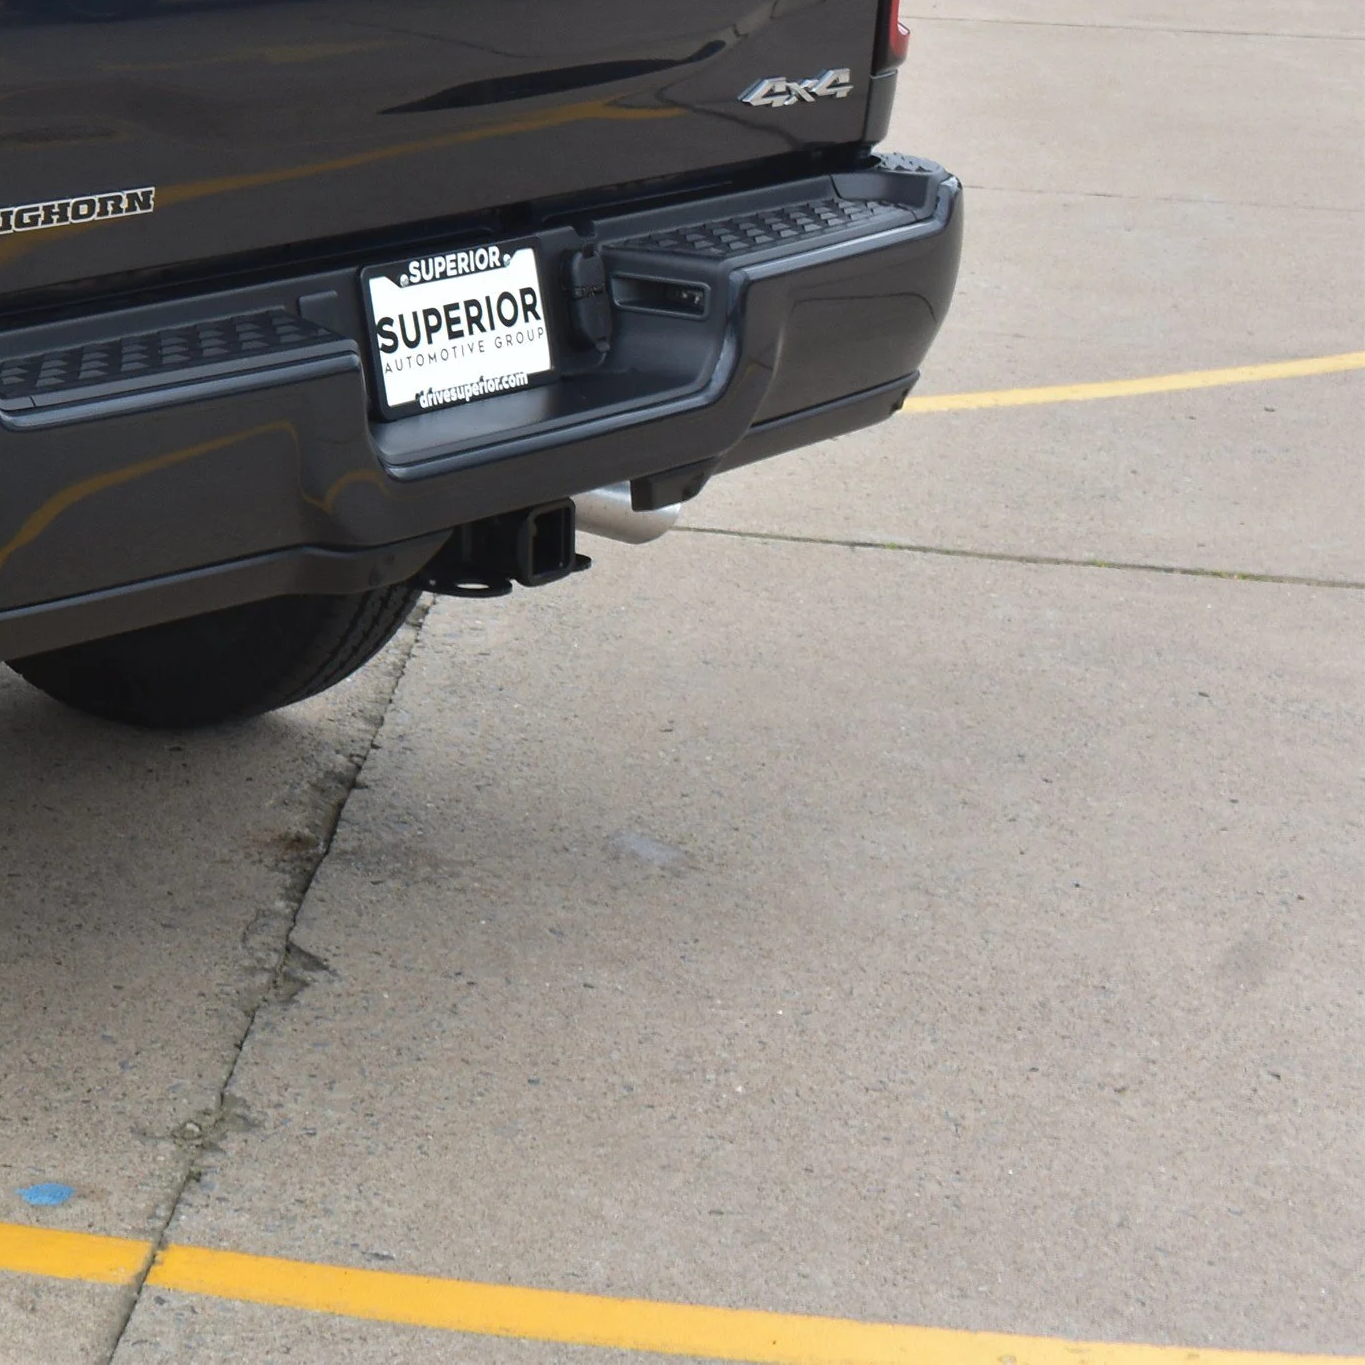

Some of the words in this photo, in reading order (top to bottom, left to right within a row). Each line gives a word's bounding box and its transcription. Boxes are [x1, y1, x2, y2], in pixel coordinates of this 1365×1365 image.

[407, 245, 502, 284] SUPERIOR
[375, 286, 542, 355] SUPERIOR
[384, 339, 486, 375] AUTOMOTIVE
[494, 326, 545, 350] GROUP
[418, 372, 528, 408] drivesuperior.com
